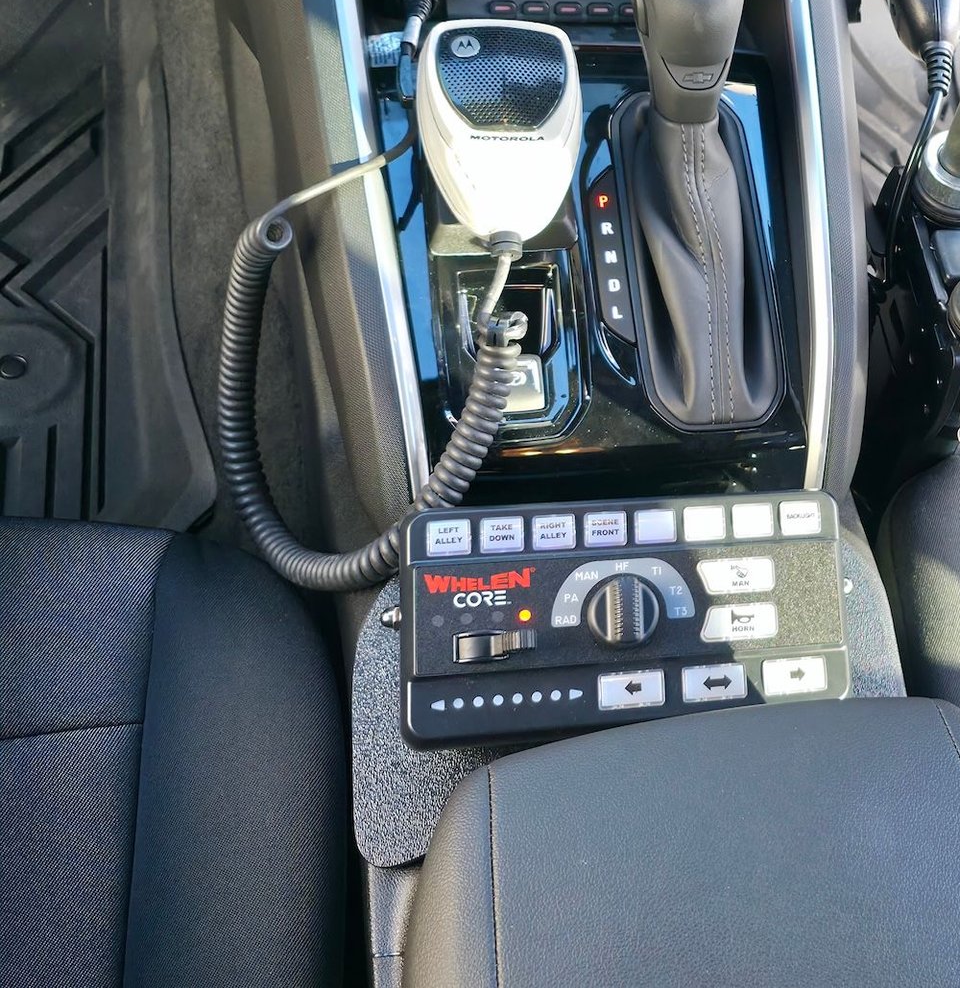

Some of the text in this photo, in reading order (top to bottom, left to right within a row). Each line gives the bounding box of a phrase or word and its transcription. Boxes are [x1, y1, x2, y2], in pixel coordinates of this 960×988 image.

[599, 195, 608, 207] P
[601, 222, 614, 235] R
[604, 250, 618, 264] N
[608, 278, 621, 293] D
[612, 306, 623, 319] L
[490, 523, 513, 532] TAKE
[540, 532, 567, 540] ALLEY
[591, 528, 620, 537] FRONT
[435, 537, 463, 545] ALLEY
[489, 534, 515, 542] DOWN
[615, 562, 629, 571] HF
[575, 570, 599, 581] MAN
[424, 567, 532, 594] WHELEN
[669, 586, 683, 595] T2
[453, 590, 506, 608] CORE
[564, 594, 579, 603] PA
[674, 607, 688, 616] T3
[555, 616, 577, 625] RAD
